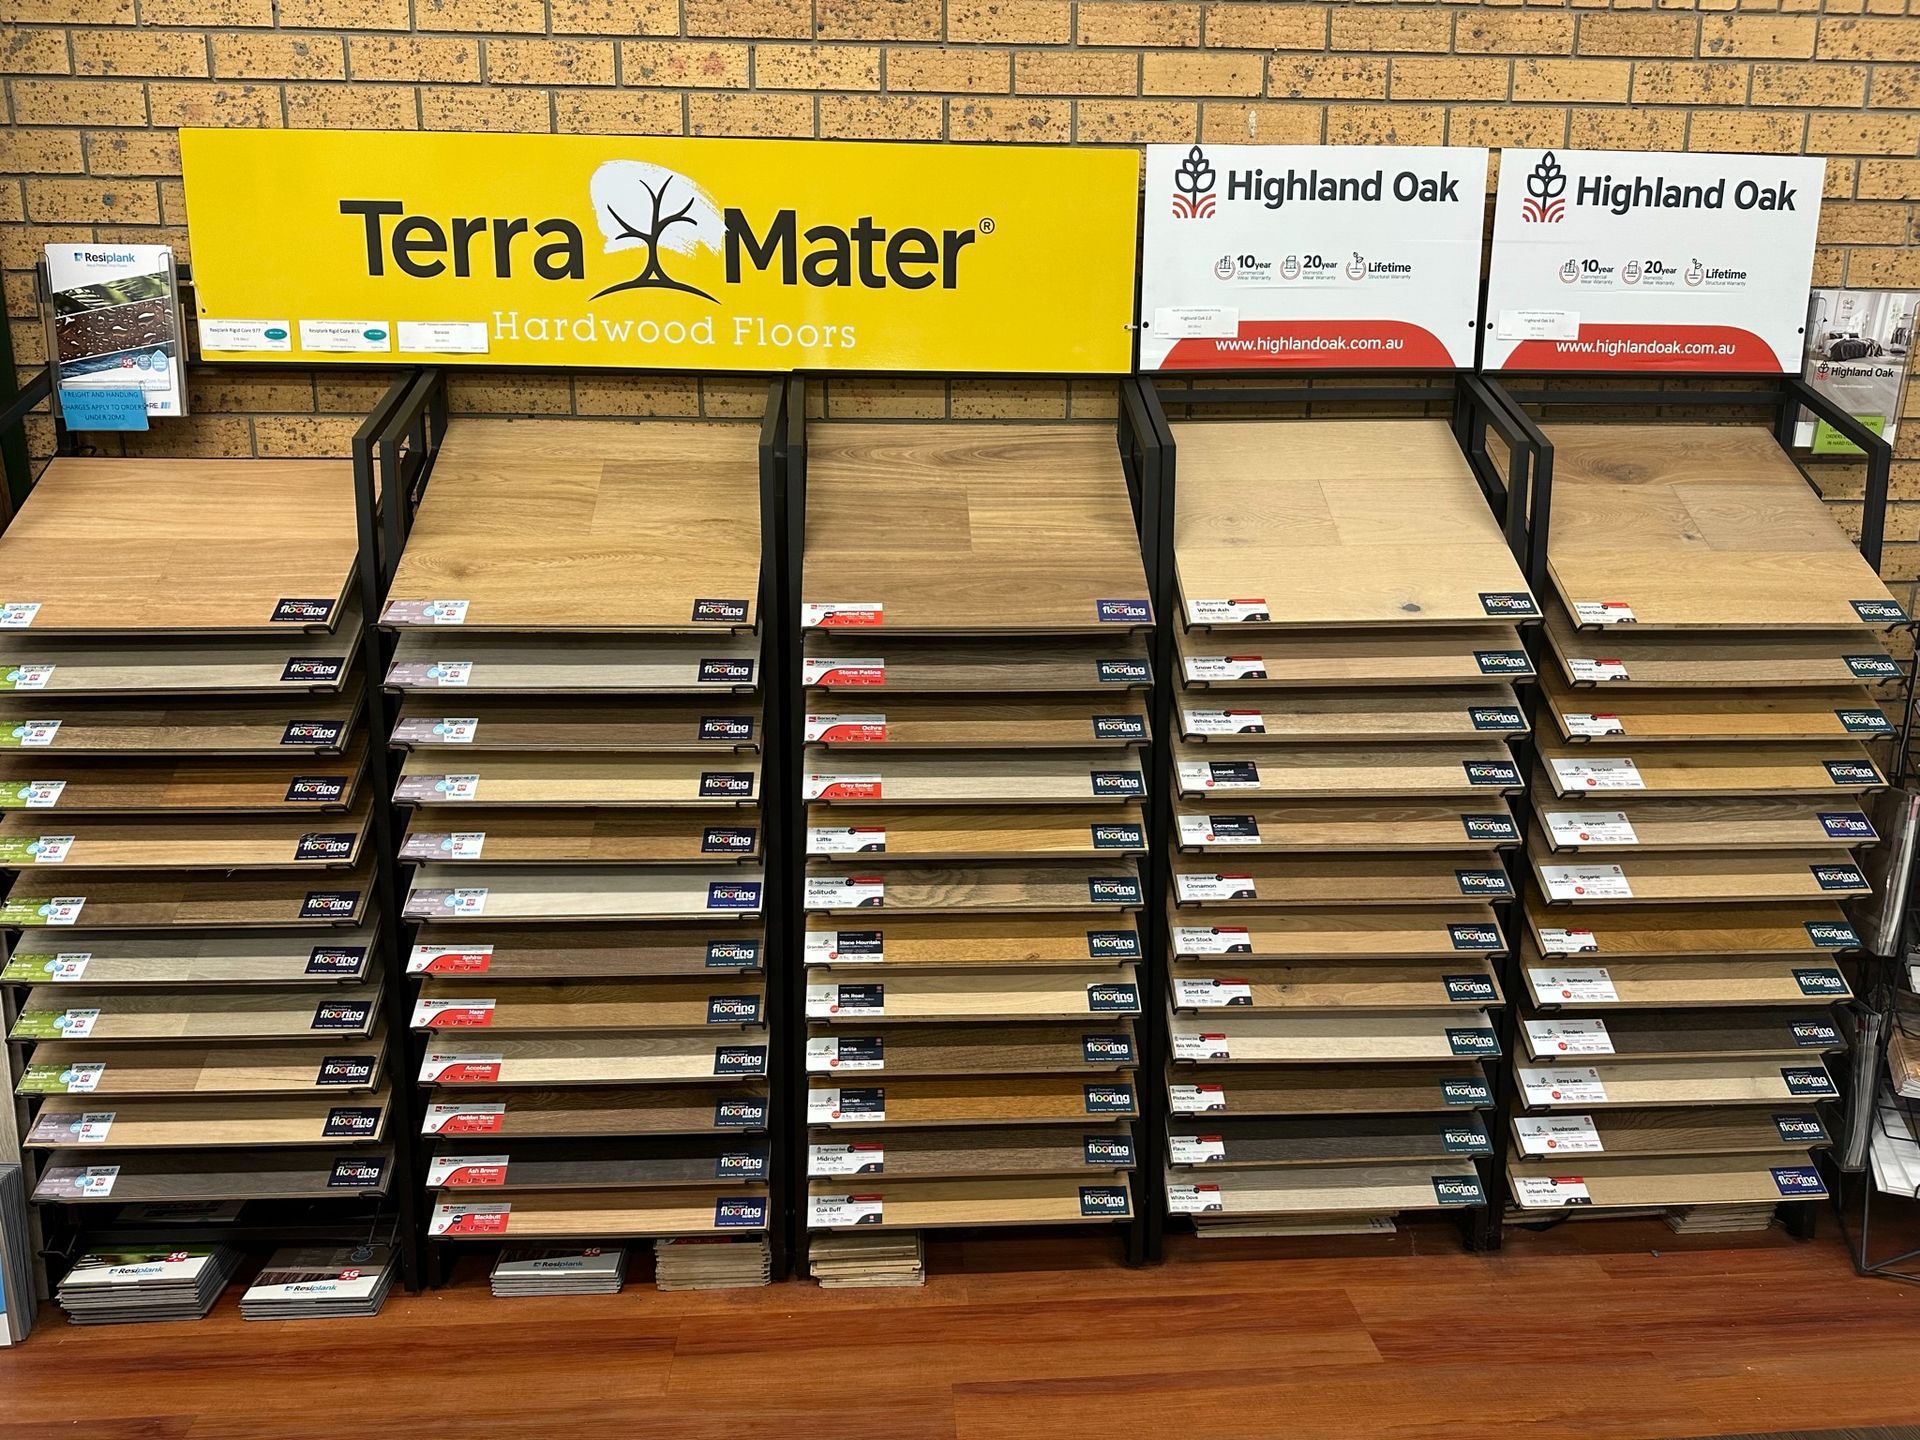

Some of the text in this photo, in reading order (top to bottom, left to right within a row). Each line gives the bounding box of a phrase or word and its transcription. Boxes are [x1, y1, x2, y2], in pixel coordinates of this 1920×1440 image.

[1228, 168, 1460, 210] Highland Oak
[1576, 175, 1797, 216] Highland Oak
[339, 199, 585, 281] Terra
[85, 252, 135, 264] Resiplank
[1368, 262, 1411, 274] Lifetime
[1705, 268, 1747, 280] Lifetime
[494, 311, 856, 349] Hardwood Floors
[1215, 335, 1404, 354] www.highlandoak.com.au
[1556, 340, 1736, 356] www.highlandoak.com.au
[1831, 367, 1894, 379] Highland Oak
[280, 605, 327, 615] flooring
[698, 605, 743, 615] flooring
[1858, 605, 1902, 616] flooring
[1481, 657, 1526, 667] flooring
[1102, 665, 1146, 675] flooring
[1843, 715, 1885, 725] flooring
[705, 723, 749, 733] flooring
[1097, 721, 1141, 731] flooring
[290, 727, 337, 737] flooring
[1470, 767, 1514, 778] flooring
[705, 779, 749, 789] flooring
[1826, 820, 1867, 830] flooring
[1096, 830, 1139, 841] flooring
[303, 841, 349, 851] flooring
[1465, 875, 1505, 886] flooring
[713, 889, 756, 900] flooring
[308, 899, 353, 909] flooring
[1811, 928, 1853, 939] flooring
[1093, 938, 1134, 949] flooring
[1800, 977, 1841, 987] flooring
[1450, 983, 1492, 993] flooring
[713, 1003, 755, 1014] flooring
[320, 1009, 364, 1020] flooring
[1087, 1043, 1128, 1054] flooring
[1788, 1075, 1828, 1086] flooring
[1445, 1086, 1487, 1097] flooring
[720, 1107, 762, 1117] flooring
[331, 1116, 374, 1126] flooring
[1446, 1133, 1486, 1144] flooring
[1088, 1144, 1129, 1155] flooring
[1778, 1177, 1819, 1187] flooring
[1084, 1195, 1125, 1206] flooring
[719, 1207, 761, 1217] flooring
[168, 1251, 189, 1262] 5G
[585, 1247, 601, 1256] 5G
[541, 1259, 584, 1269] Resiplank
[117, 1265, 163, 1275] Resiplank
[340, 1270, 360, 1280] 5G
[293, 1284, 337, 1293] Resiplank
